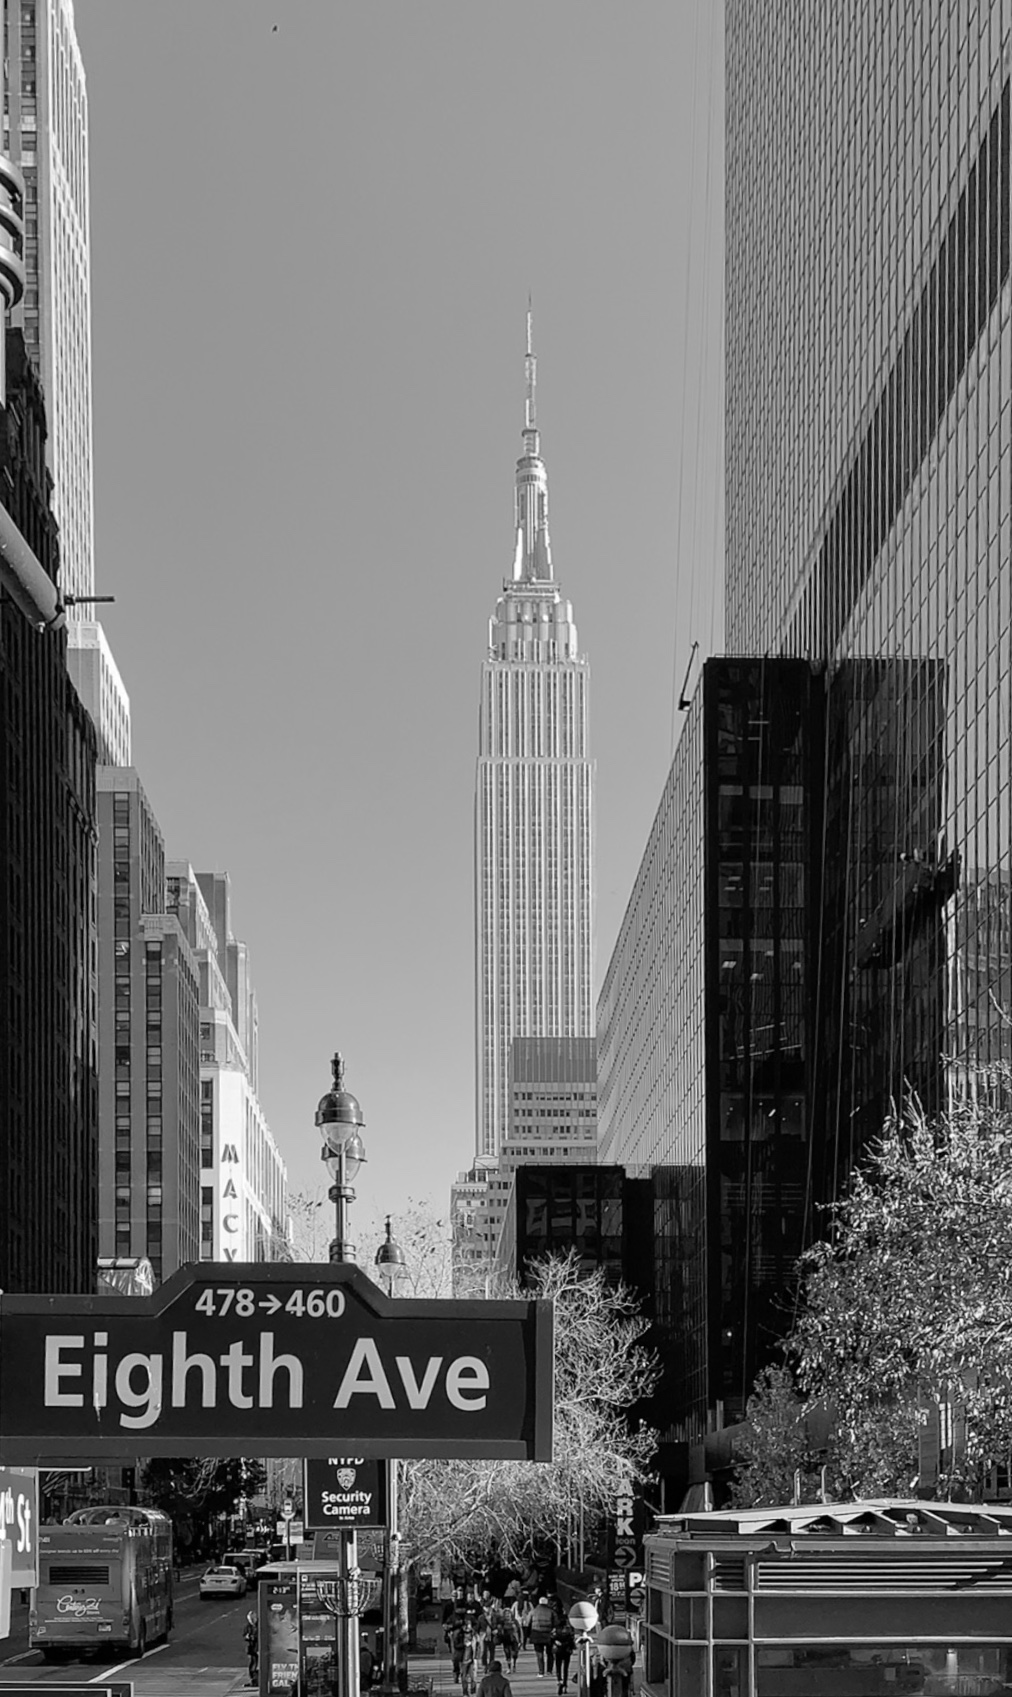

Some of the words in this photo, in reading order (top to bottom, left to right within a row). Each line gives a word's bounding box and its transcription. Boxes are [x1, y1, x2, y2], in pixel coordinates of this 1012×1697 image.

[195, 1288, 255, 1317] 478
[285, 1289, 346, 1318] 460
[44, 1331, 304, 1429] Eighth
[333, 1338, 491, 1411] Ave
[321, 1490, 372, 1504] Security
[323, 1504, 371, 1515] Camera
[17, 1493, 31, 1552] St
[272, 1663, 287, 1671] FLY
[288, 1663, 298, 1671] TH
[272, 1671, 298, 1680] FRIEN
[272, 1679, 290, 1687] GAL
